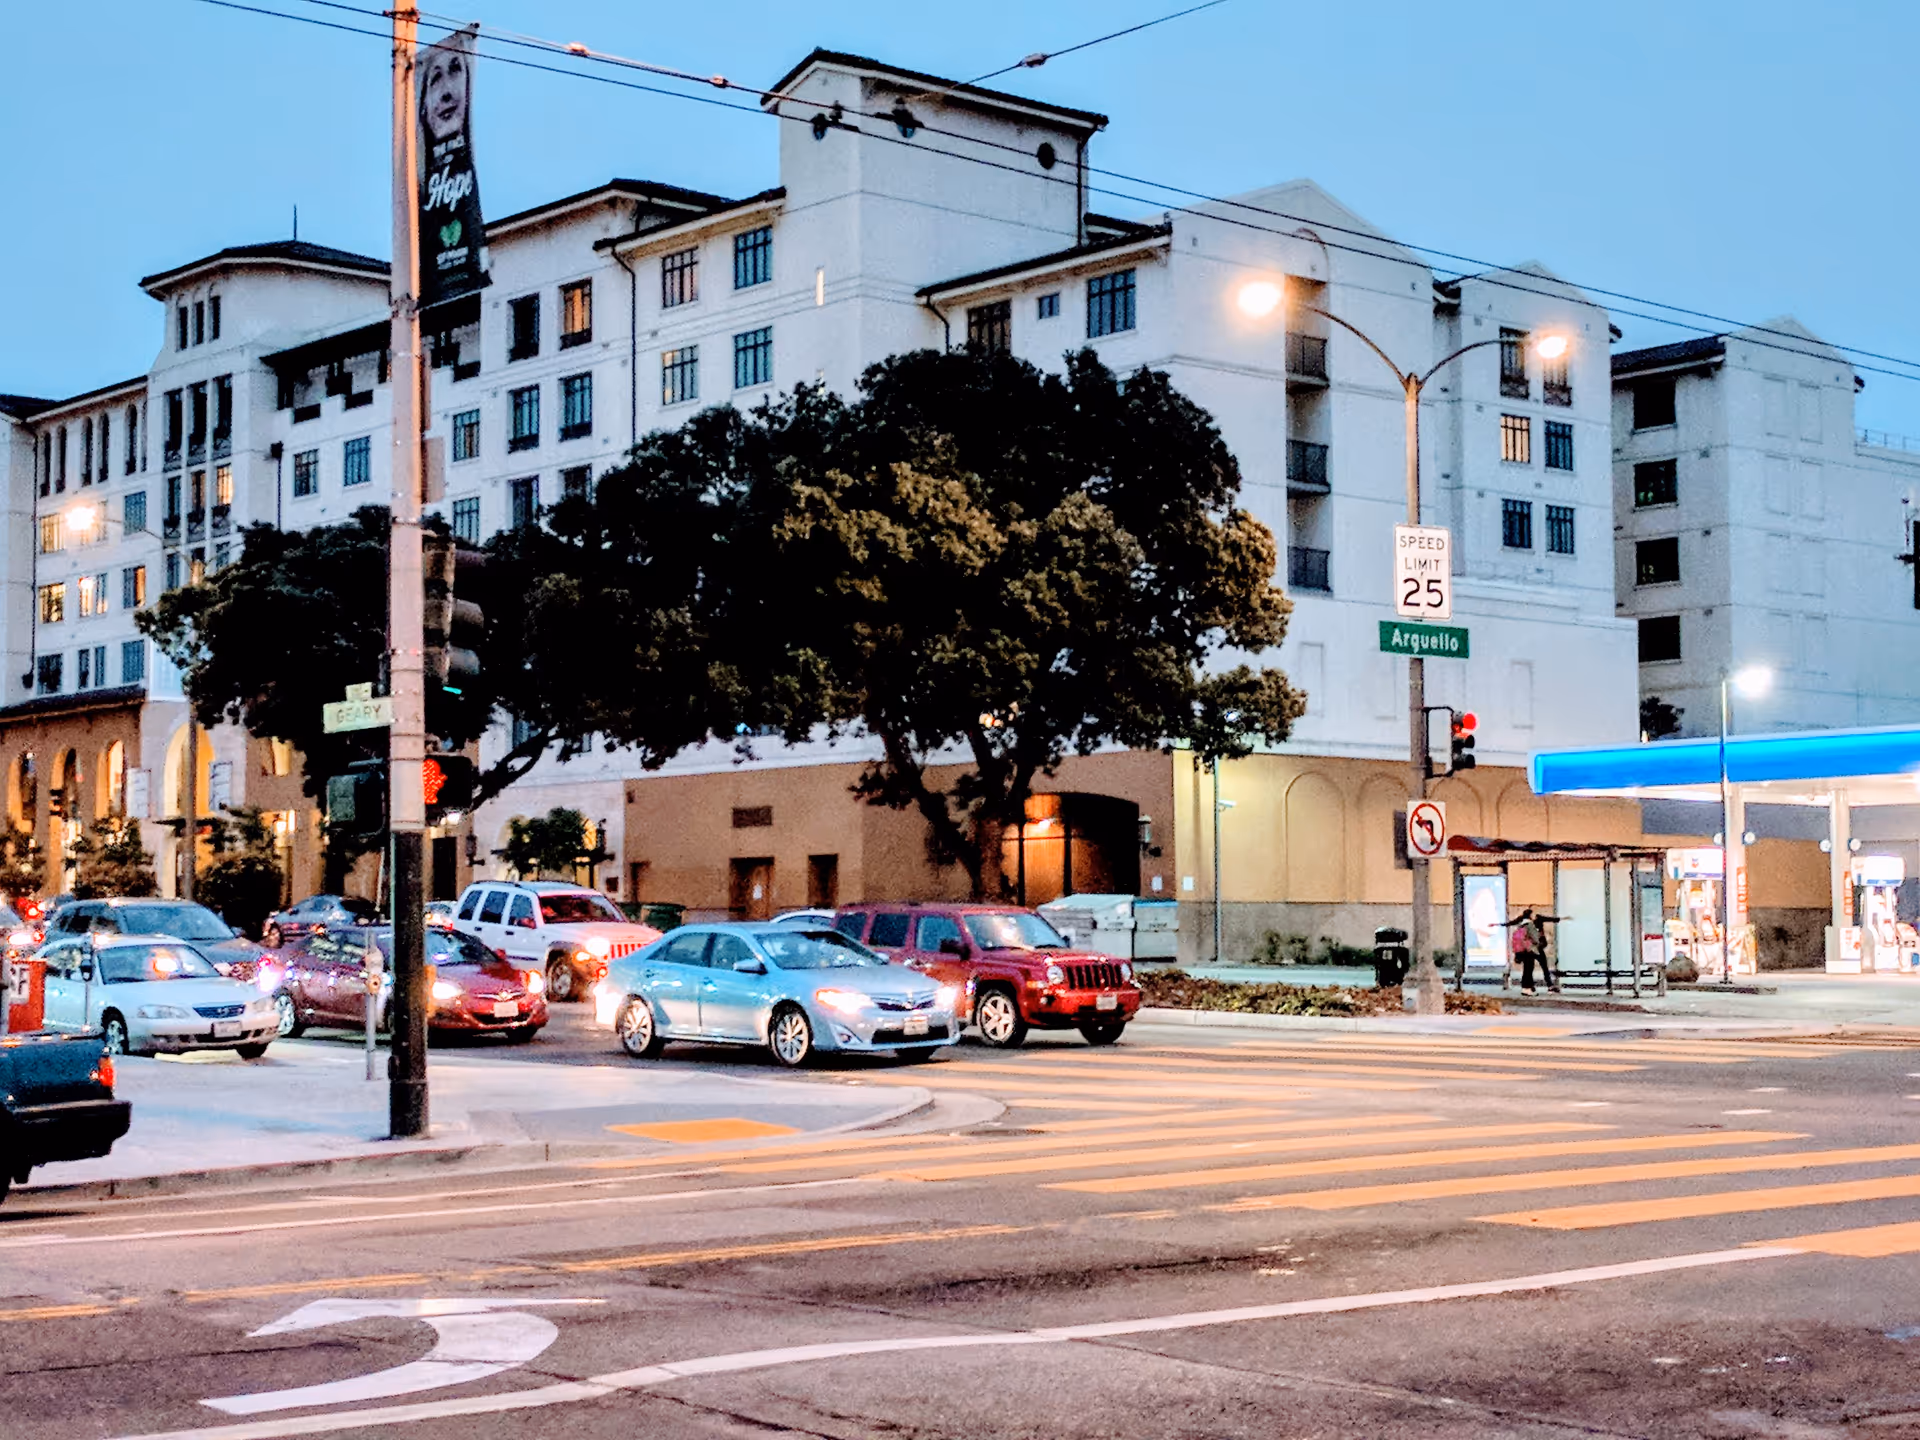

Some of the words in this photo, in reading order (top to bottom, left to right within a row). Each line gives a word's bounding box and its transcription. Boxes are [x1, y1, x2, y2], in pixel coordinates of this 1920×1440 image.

[423, 165, 474, 212] Hope
[1400, 535, 1445, 550] SPEED
[1404, 557, 1440, 571] LIMIT
[1403, 577, 1444, 608] 25
[1391, 628, 1459, 653] Arguello
[336, 703, 382, 724] GEARY
